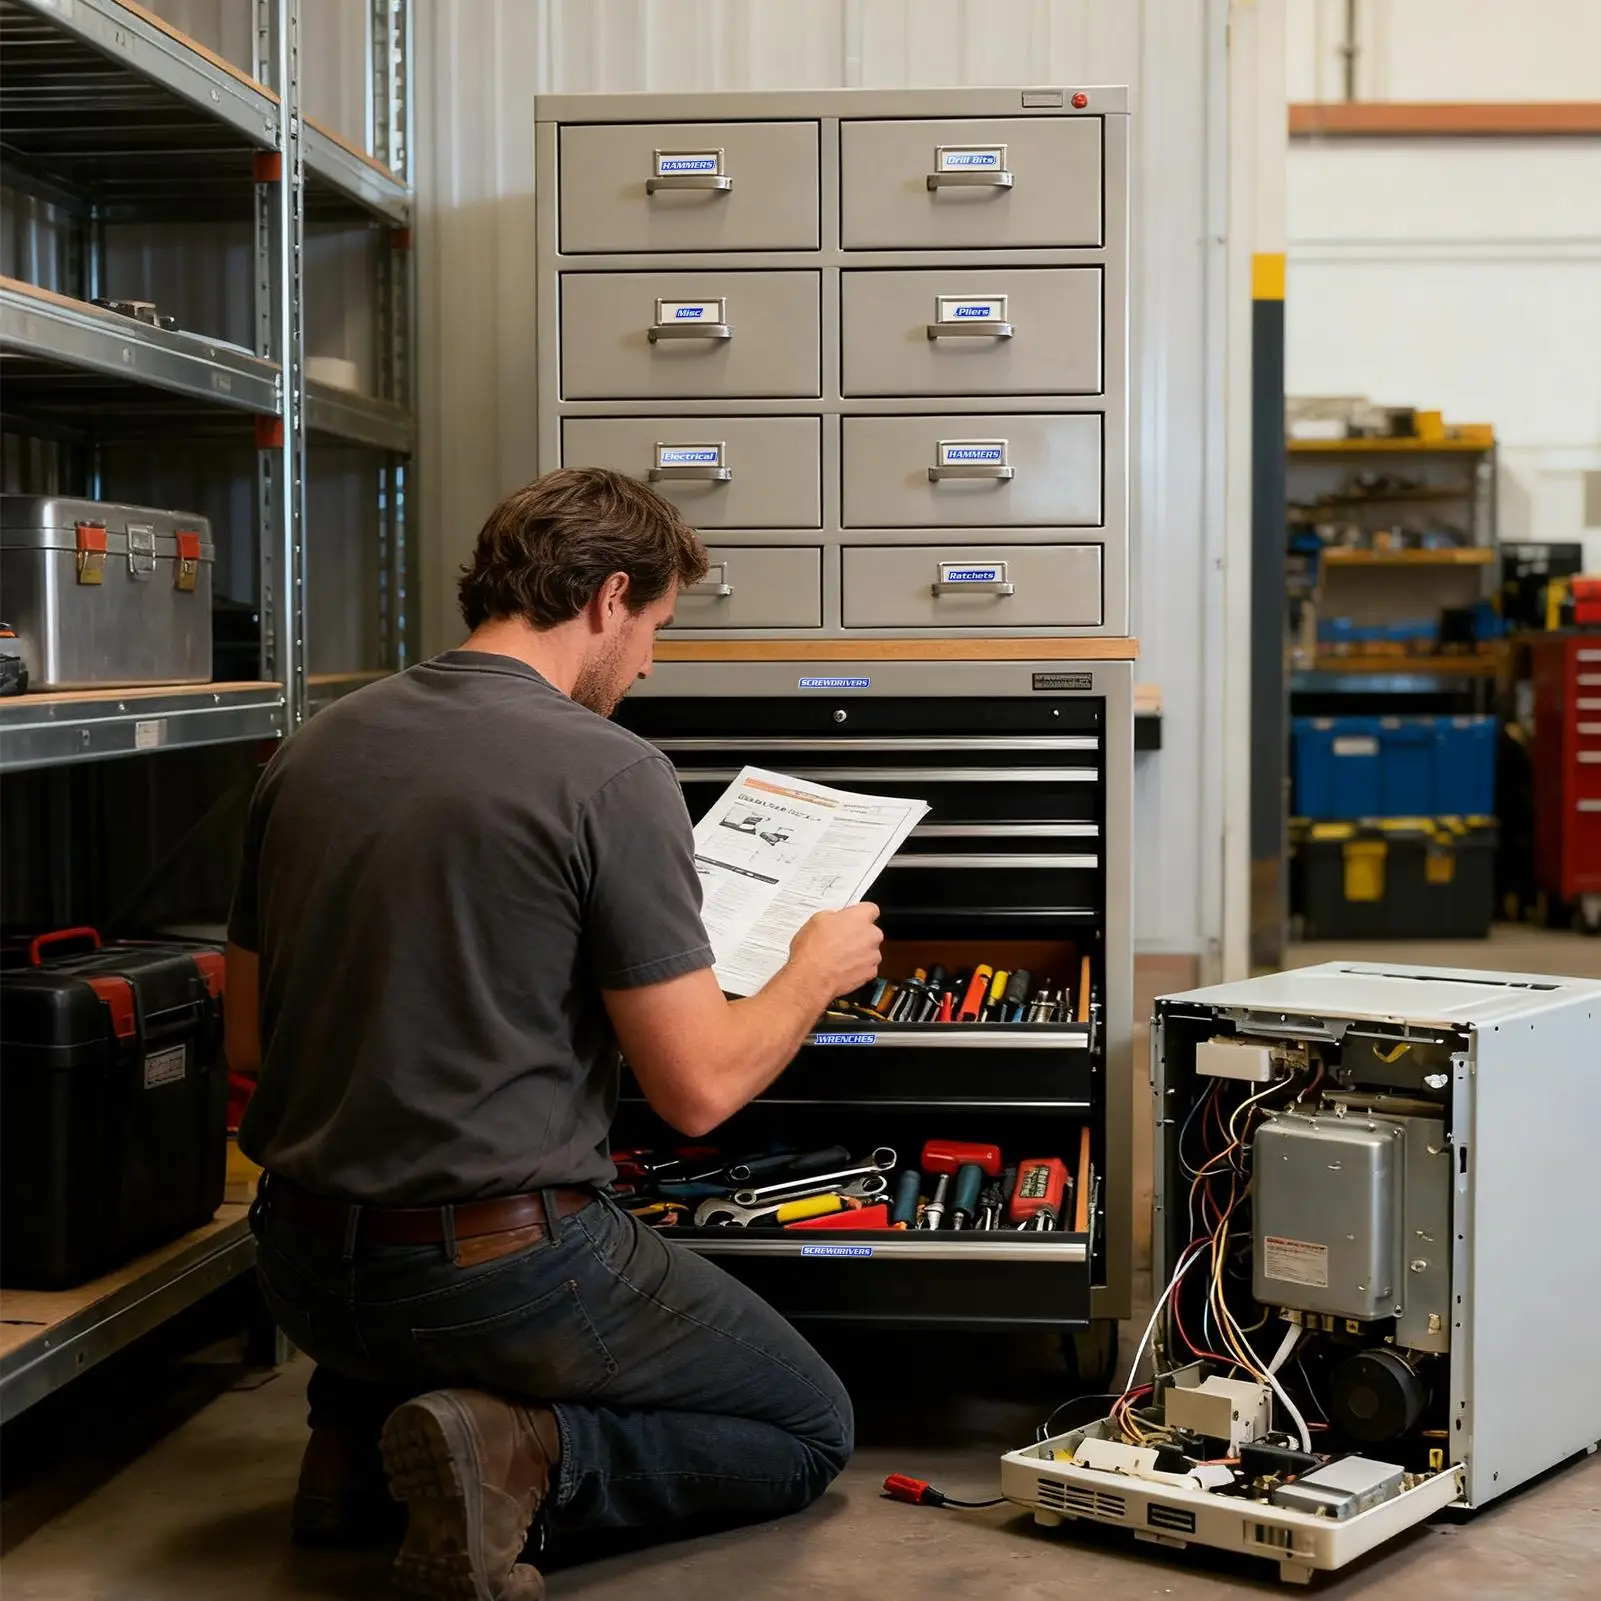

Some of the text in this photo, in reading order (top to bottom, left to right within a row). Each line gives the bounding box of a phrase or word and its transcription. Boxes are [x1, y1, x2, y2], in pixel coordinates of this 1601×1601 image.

[947, 155, 995, 164] Drill Bits
[661, 161, 714, 170] HAMMERS
[677, 308, 703, 317] Misc
[957, 308, 989, 317] Pliers
[663, 452, 715, 461] Electrical
[948, 450, 1000, 459] HAMMERS
[949, 571, 994, 580] Ratchets
[800, 679, 869, 688] SCREWDRIVERS
[817, 1035, 875, 1044] WRENCHES
[803, 1247, 872, 1256] SCREWDRIVERS
